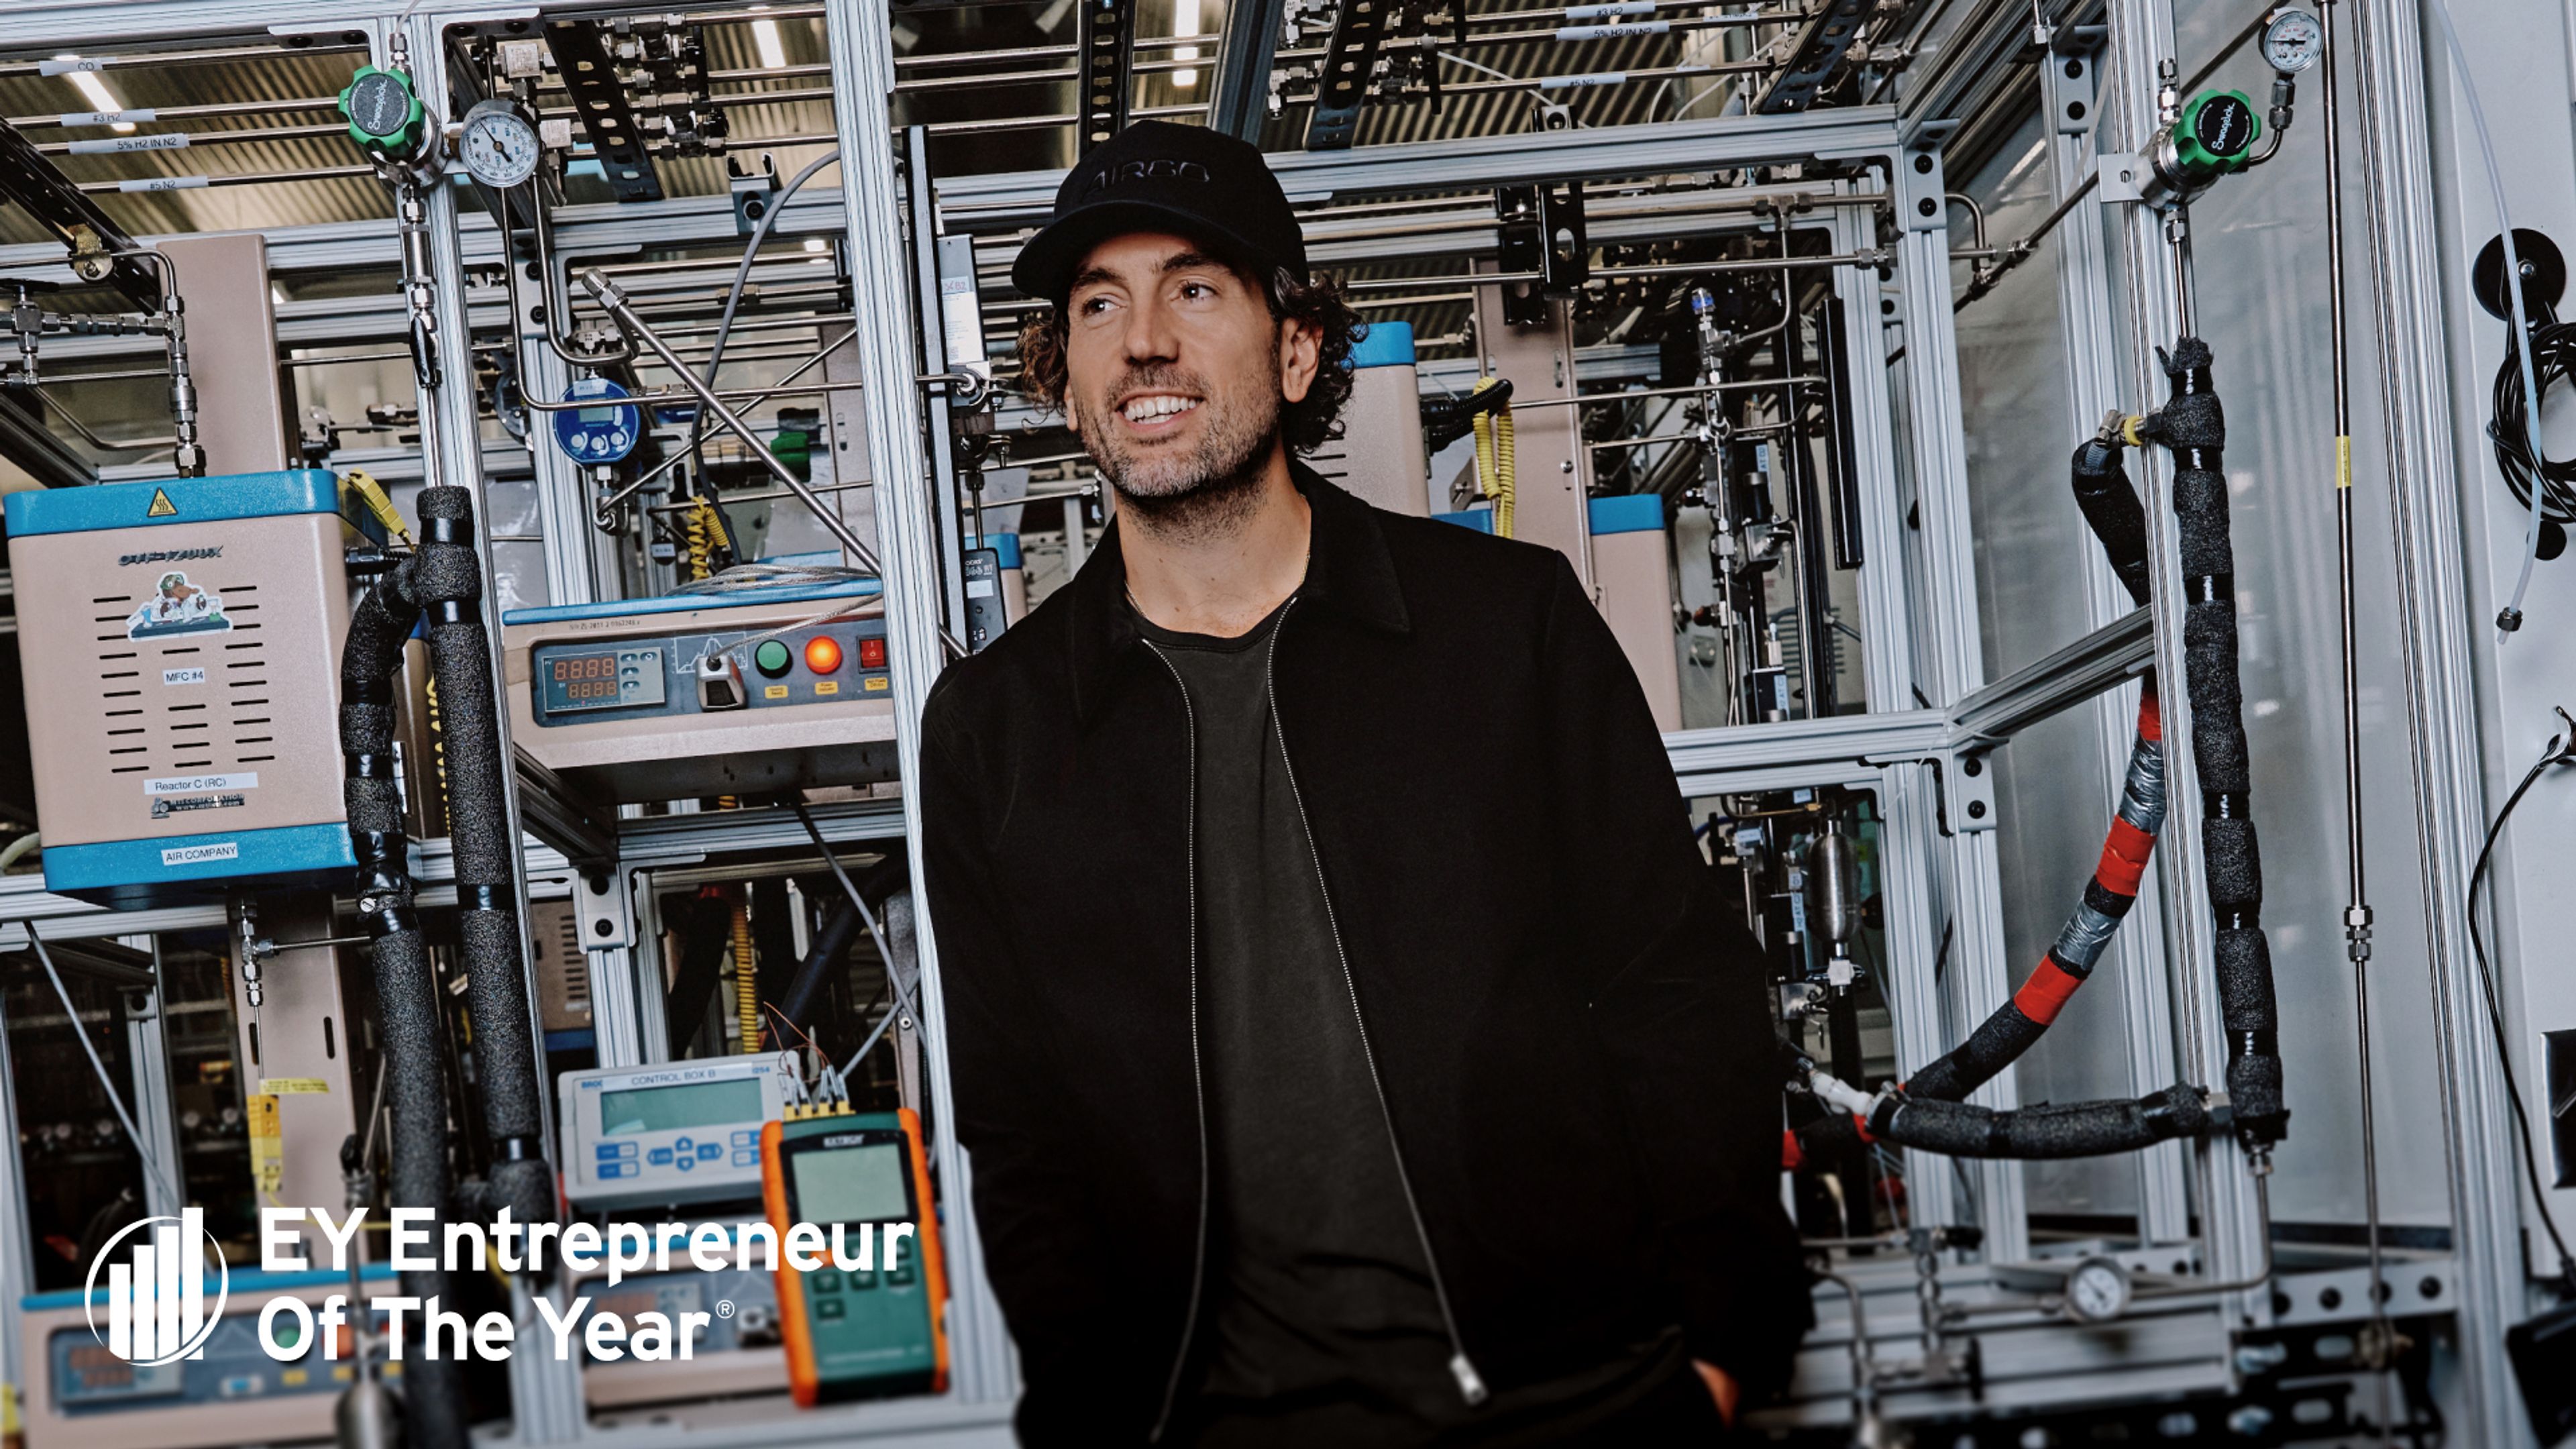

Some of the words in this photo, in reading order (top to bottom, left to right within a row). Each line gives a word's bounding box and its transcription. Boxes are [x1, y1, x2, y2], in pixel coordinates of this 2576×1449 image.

[1611, 7, 1623, 15] H2
[1611, 28, 1623, 37] H2
[2211, 102, 2236, 150] Swagelok
[117, 141, 133, 150] 5%
[135, 140, 147, 148] H2
[150, 138, 161, 147] IN
[163, 137, 177, 146] N2
[150, 181, 162, 191] #5
[163, 180, 176, 189] N2
[166, 672, 189, 682] MFC
[192, 671, 204, 680] #4
[155, 781, 192, 791] Reactor
[194, 780, 202, 789] C
[205, 778, 226, 788] (RC)
[185, 793, 244, 804] CORPOATION
[166, 852, 183, 861] AIR
[185, 846, 235, 859] COMPANY
[631, 1074, 681, 1086] CONTROL
[684, 1071, 704, 1080] BOX
[708, 1070, 716, 1078] B
